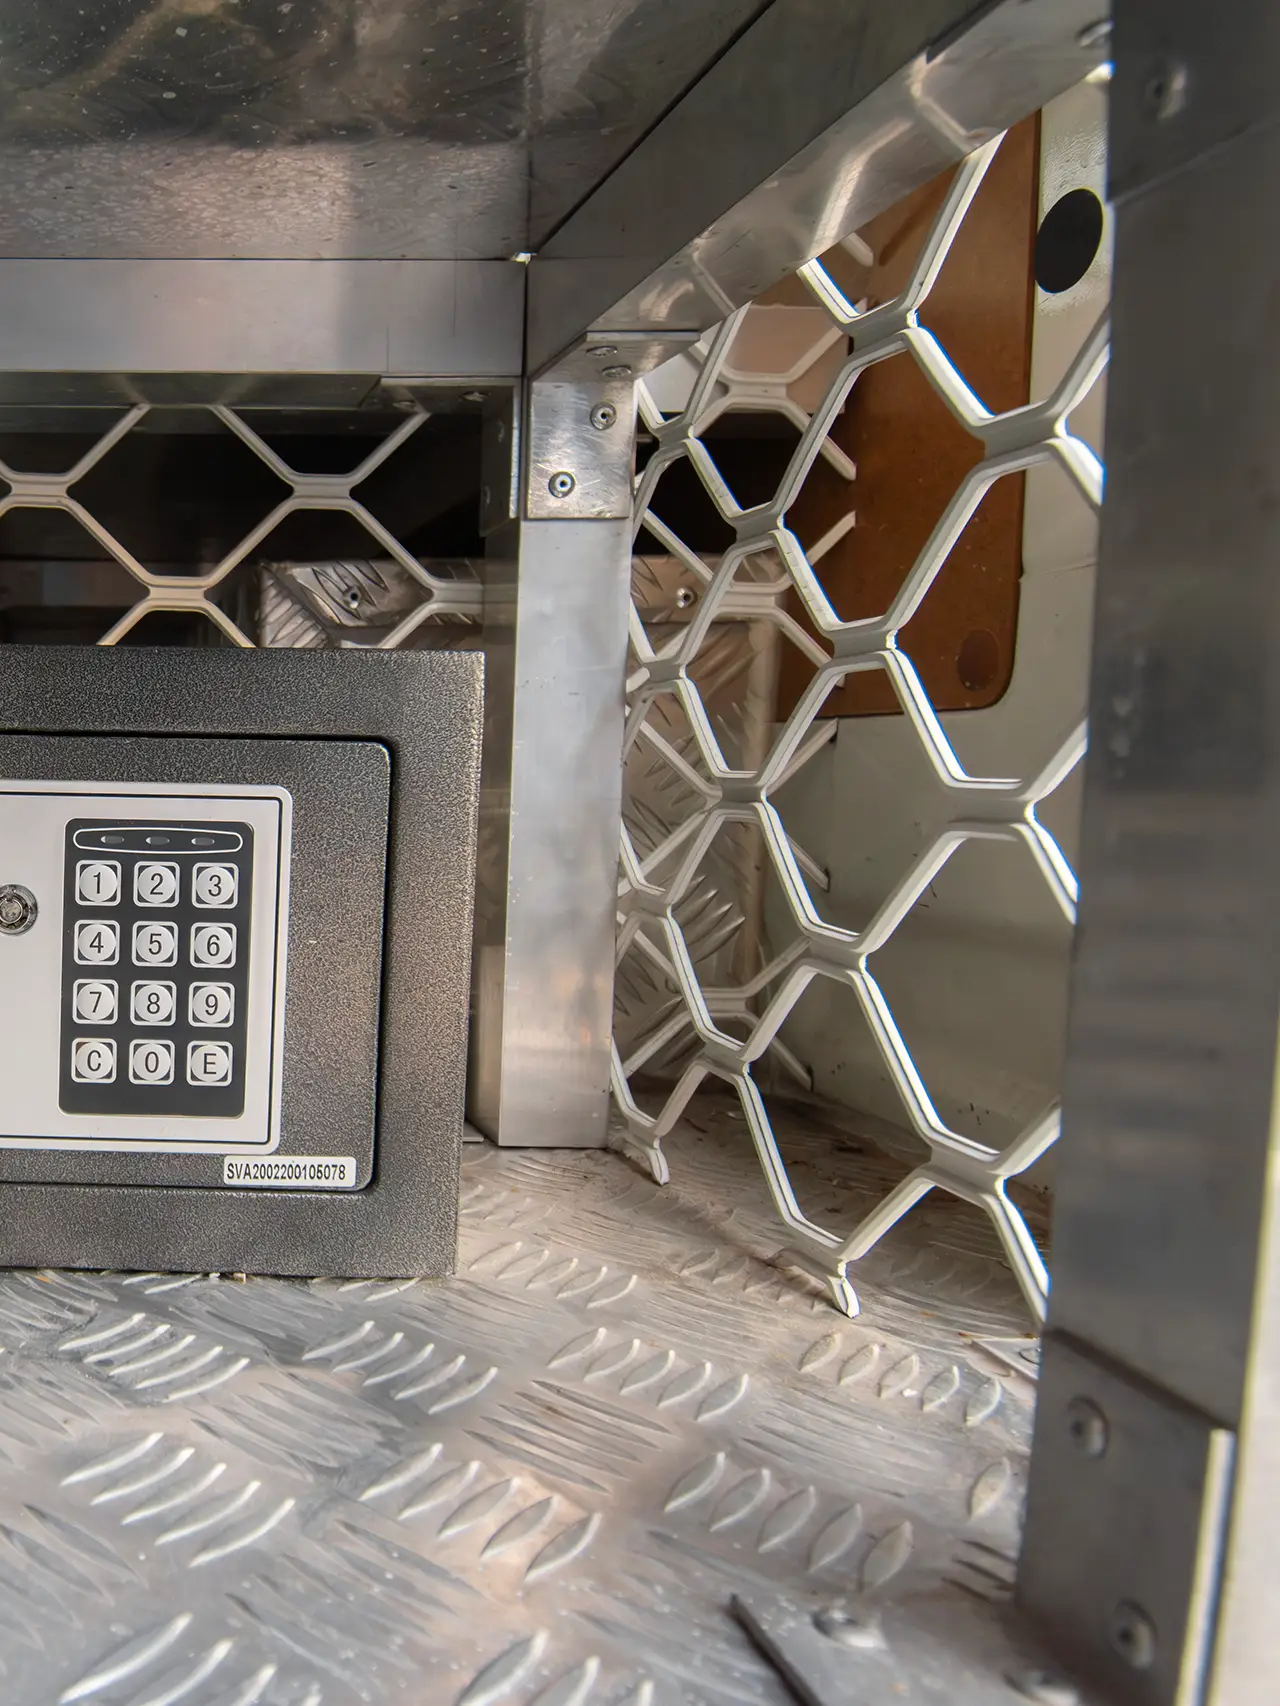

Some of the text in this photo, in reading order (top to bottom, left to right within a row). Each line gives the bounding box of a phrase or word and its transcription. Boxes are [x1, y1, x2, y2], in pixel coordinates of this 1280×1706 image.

[92, 871, 222, 897] 1 2 3
[89, 931, 220, 957] 4 5 6
[89, 991, 218, 1016] 7 8 9
[87, 1049, 217, 1075] C 0 E
[226, 1162, 346, 1181] SVA2002200105078
